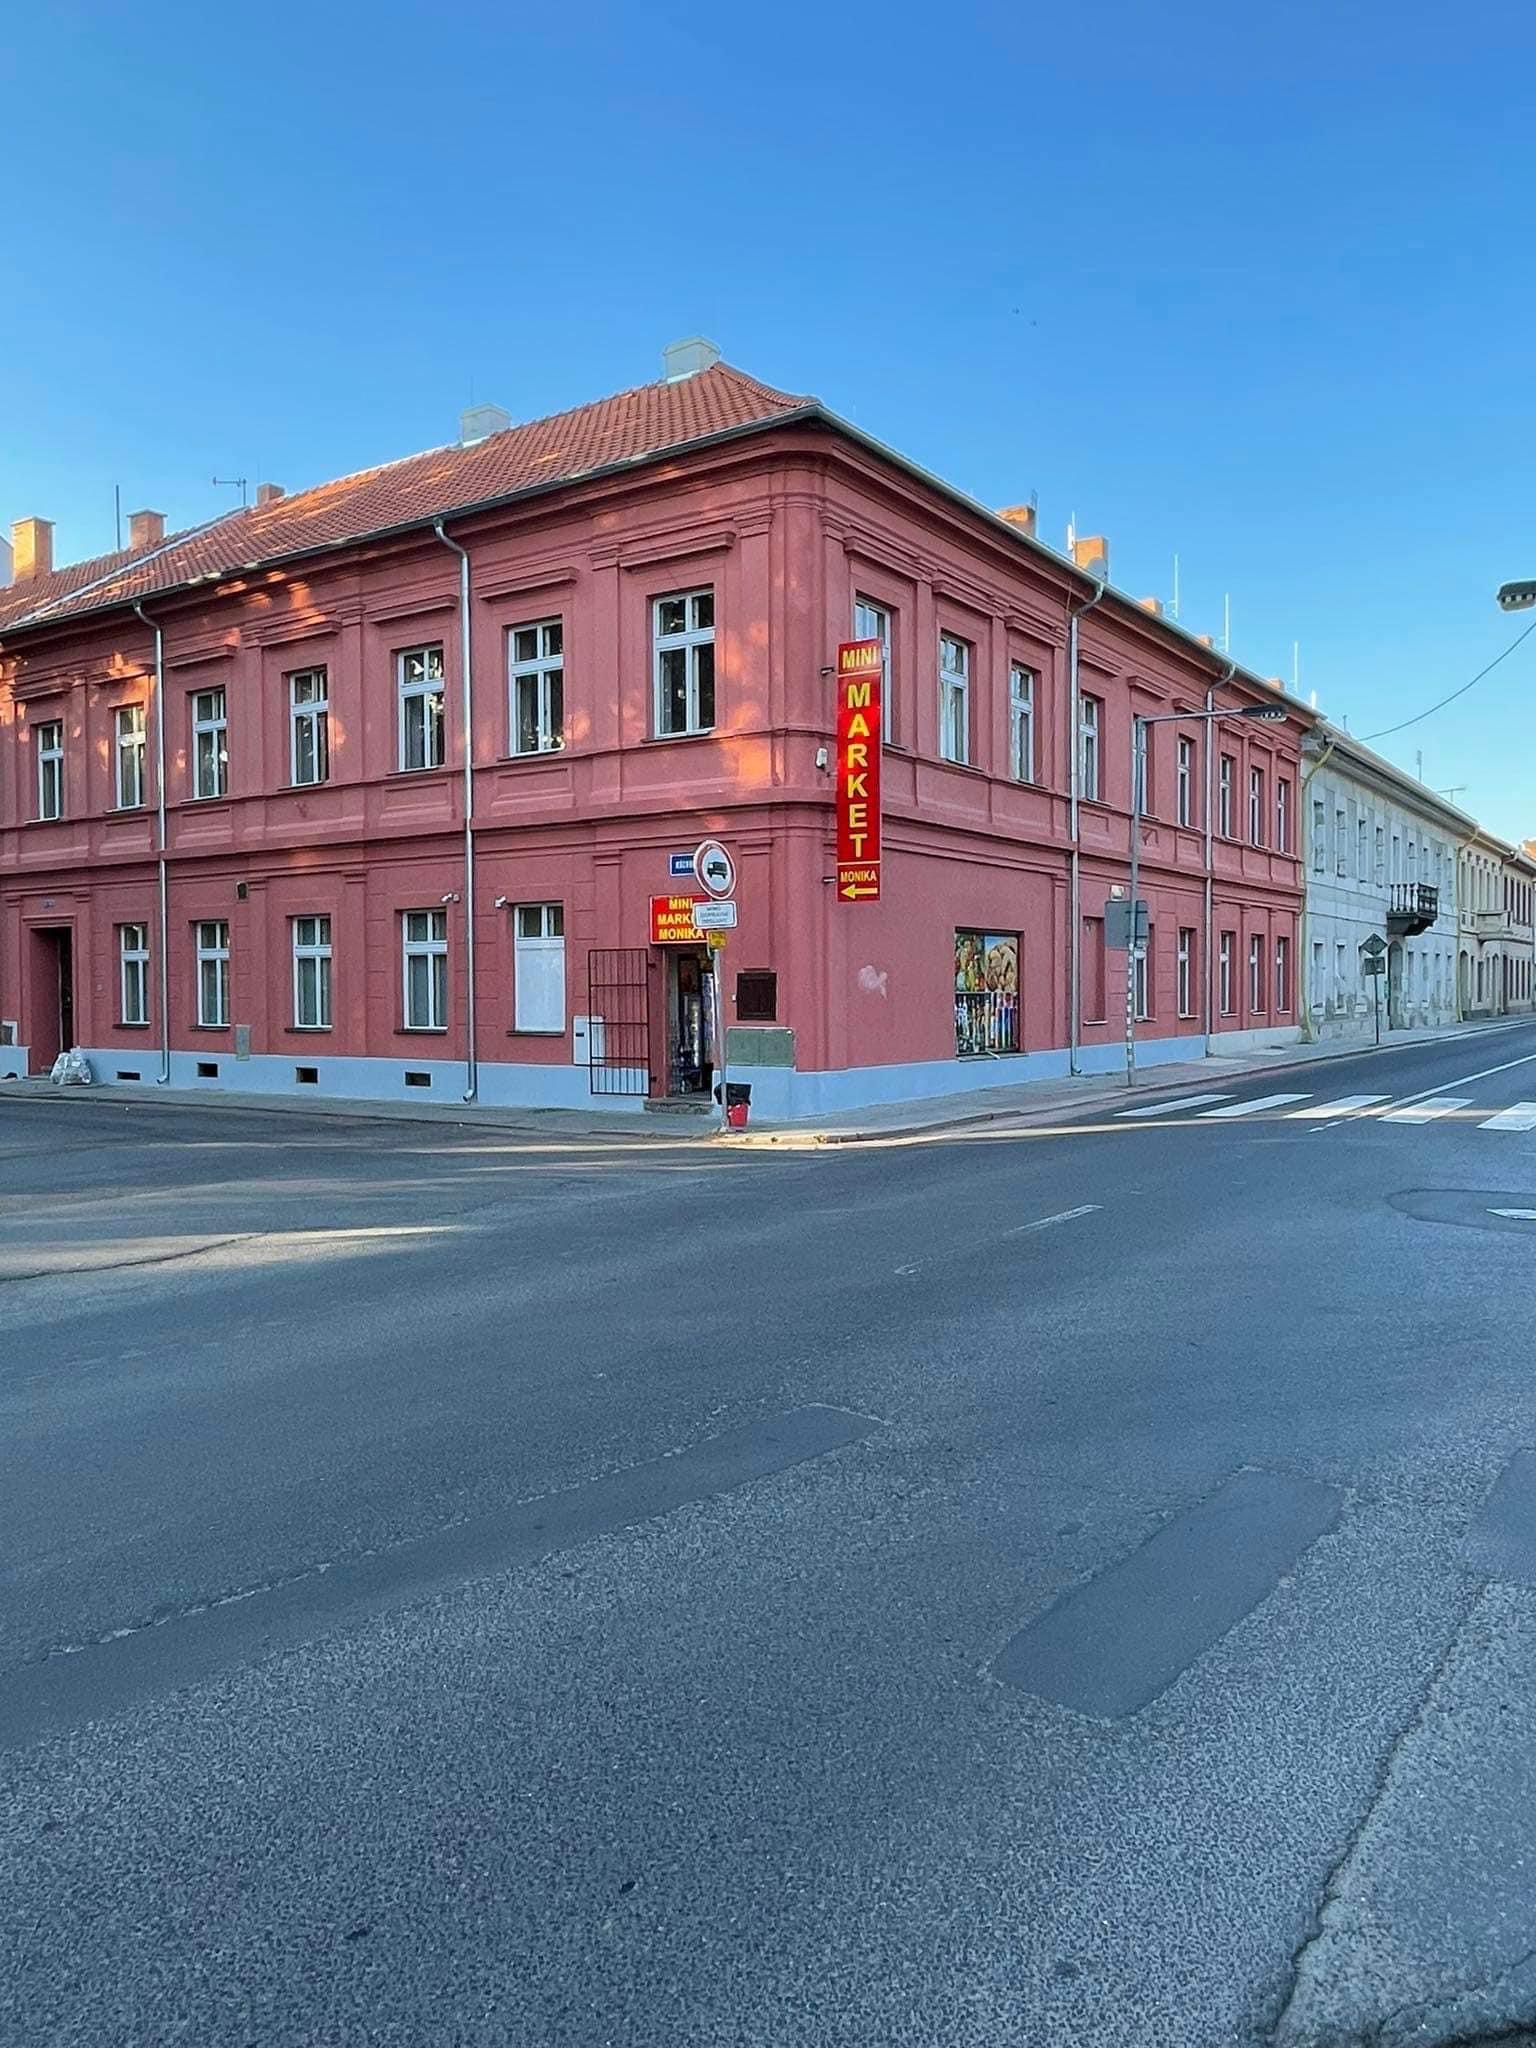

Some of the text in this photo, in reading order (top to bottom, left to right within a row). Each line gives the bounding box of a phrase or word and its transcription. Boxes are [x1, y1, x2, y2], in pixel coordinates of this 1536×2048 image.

[842, 646, 877, 669] MINI
[847, 682, 871, 858] MARKET
[840, 870, 878, 882] MONIKA
[668, 897, 693, 910] MINI
[657, 913, 691, 925] MARK
[658, 928, 705, 940] MONIKA
